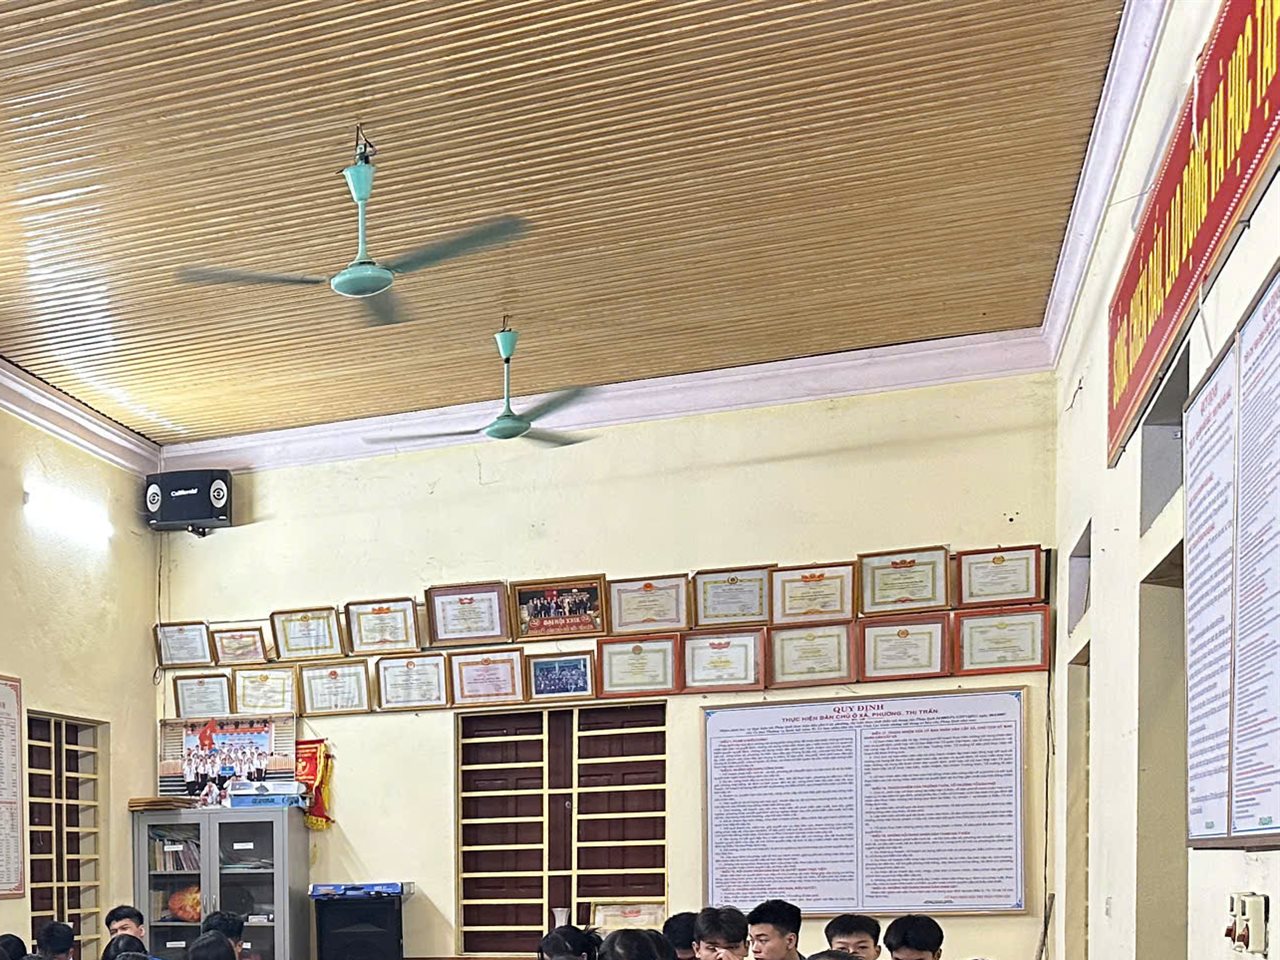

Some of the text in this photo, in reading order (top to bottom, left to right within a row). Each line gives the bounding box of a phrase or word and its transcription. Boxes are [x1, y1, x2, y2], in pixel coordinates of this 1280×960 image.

[1166, 184, 1181, 299] LAO
[1211, 58, 1224, 202] VÀ
[1227, 14, 1252, 177] HỌC
[858, 704, 884, 712] ĐỊNH
